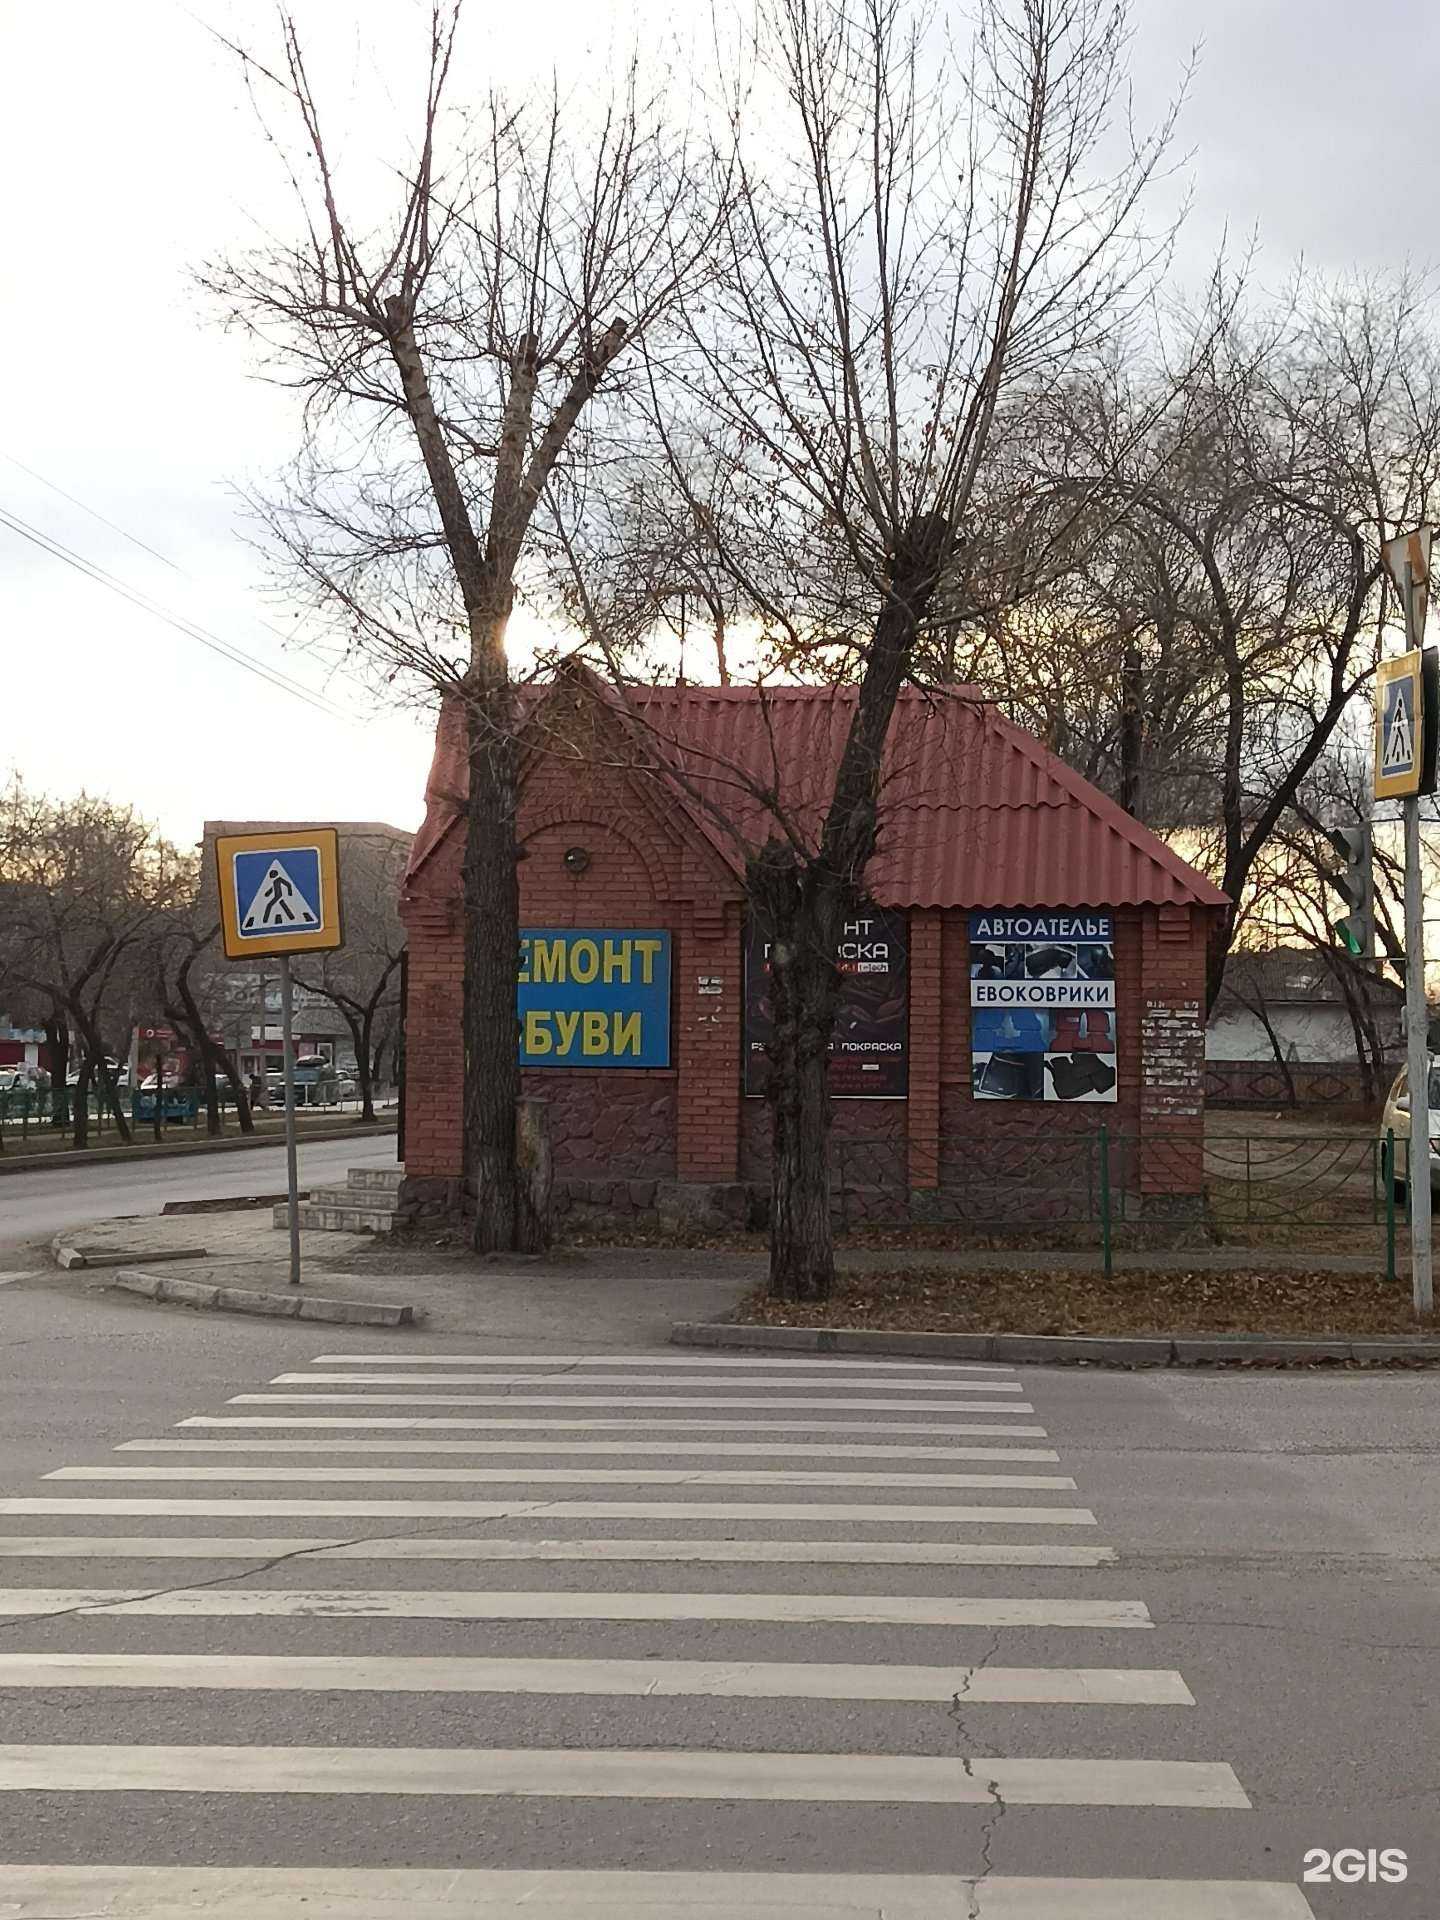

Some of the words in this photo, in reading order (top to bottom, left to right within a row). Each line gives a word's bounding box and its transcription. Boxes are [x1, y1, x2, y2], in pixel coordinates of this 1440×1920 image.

[976, 918, 1109, 936] АВТОАТЕЛЬЕ
[518, 939, 662, 984] ЕМОНТ
[976, 985, 1109, 1002] ЕВОКОВРИКИ
[520, 1010, 642, 1056] БУВИ
[841, 1042, 902, 1051] ПОКРАСКА
